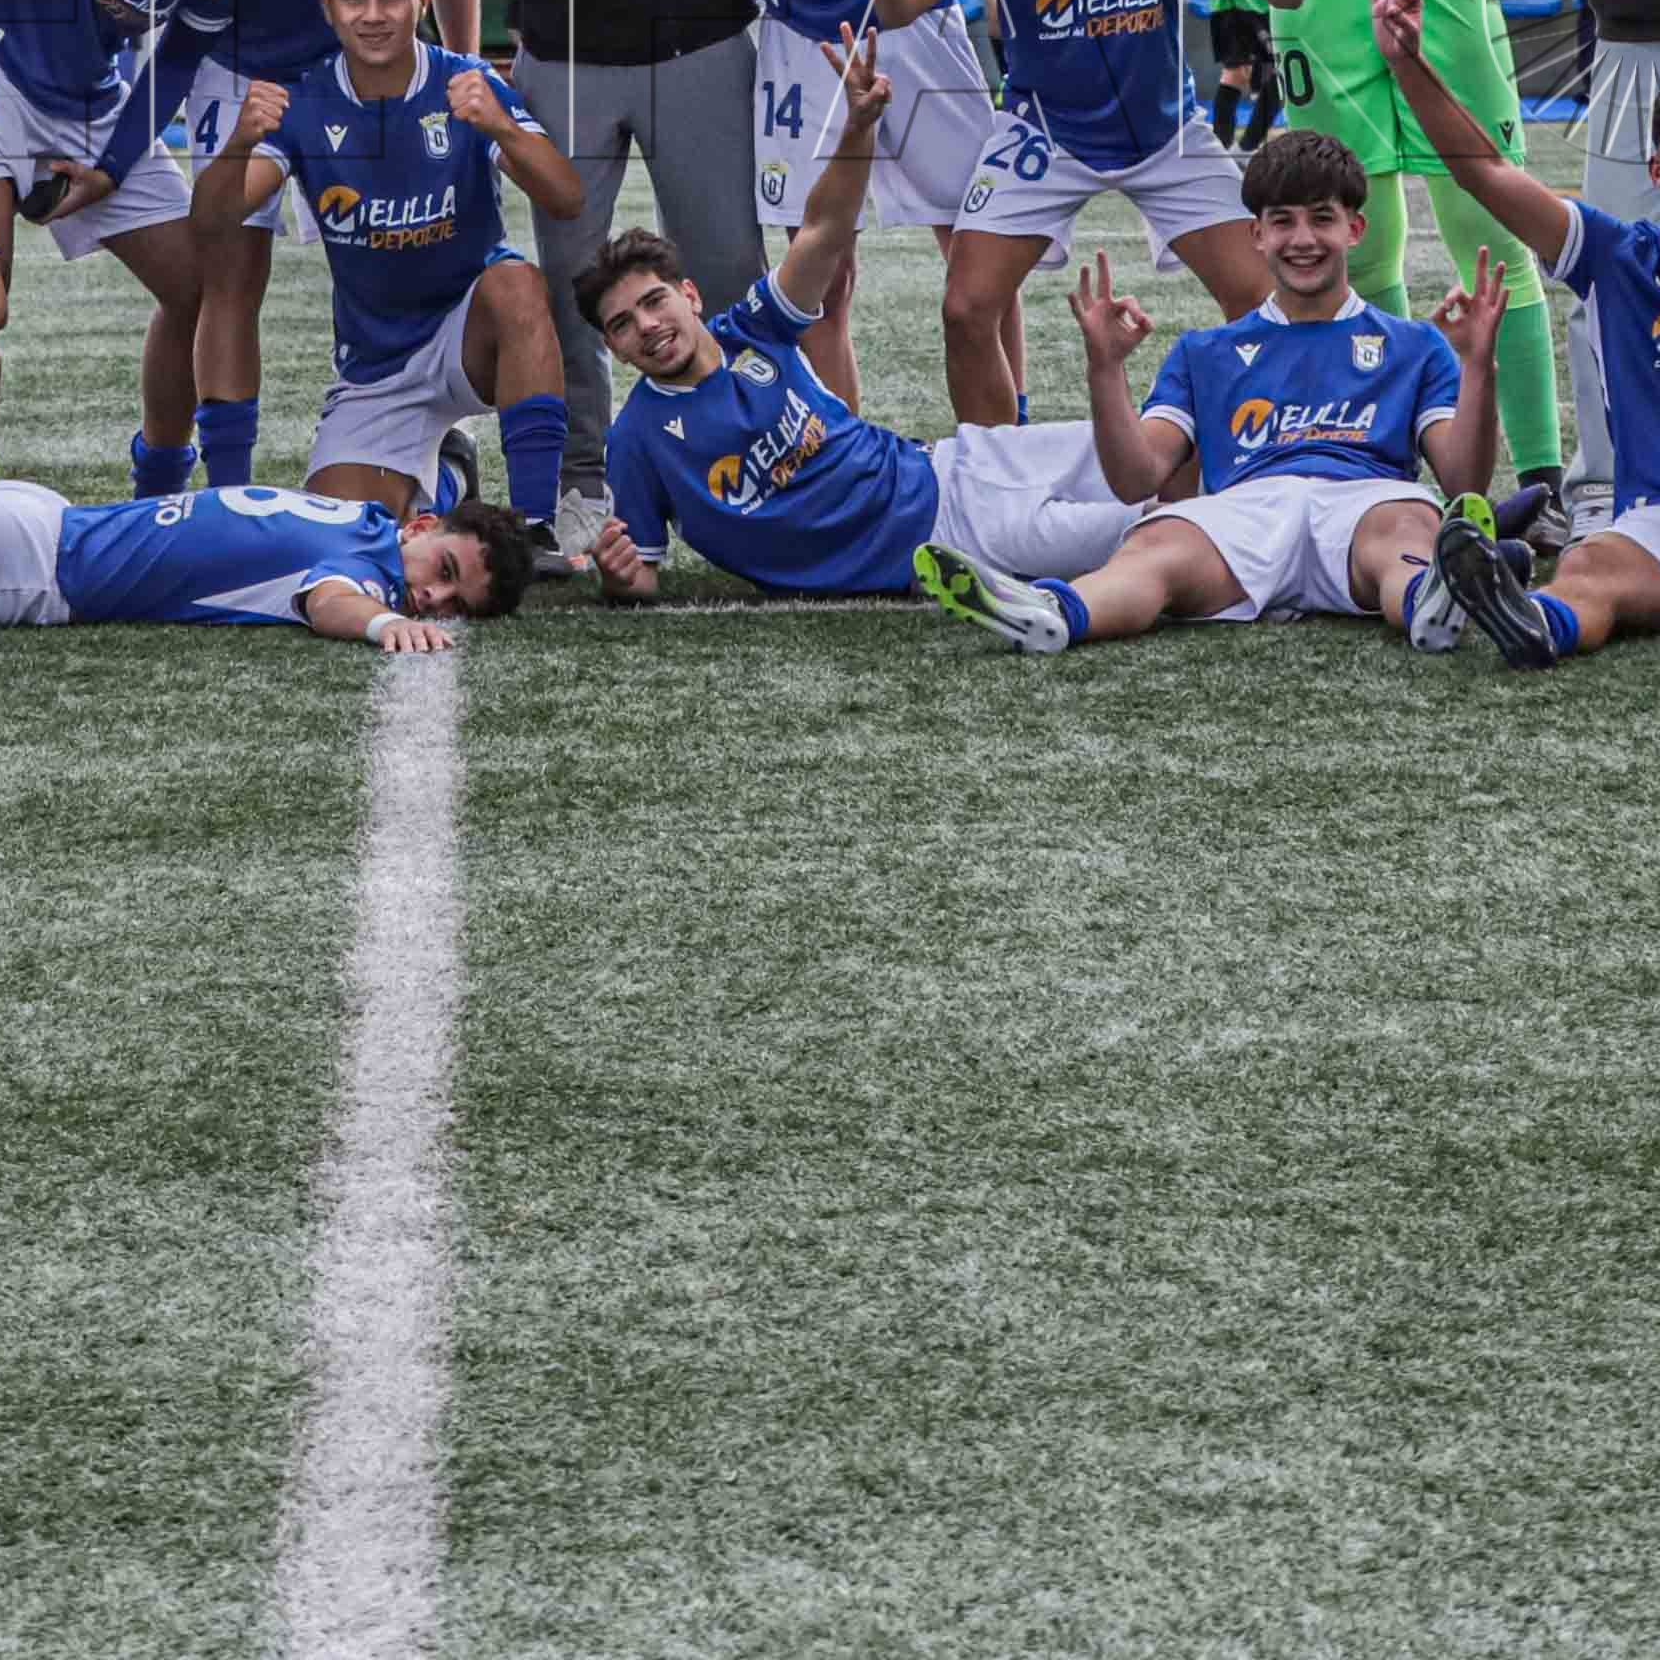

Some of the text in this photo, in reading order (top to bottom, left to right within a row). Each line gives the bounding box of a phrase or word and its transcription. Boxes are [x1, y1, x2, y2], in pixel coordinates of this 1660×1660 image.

[195, 99, 221, 154] 4
[762, 80, 804, 139] 14
[983, 123, 1050, 181] 26
